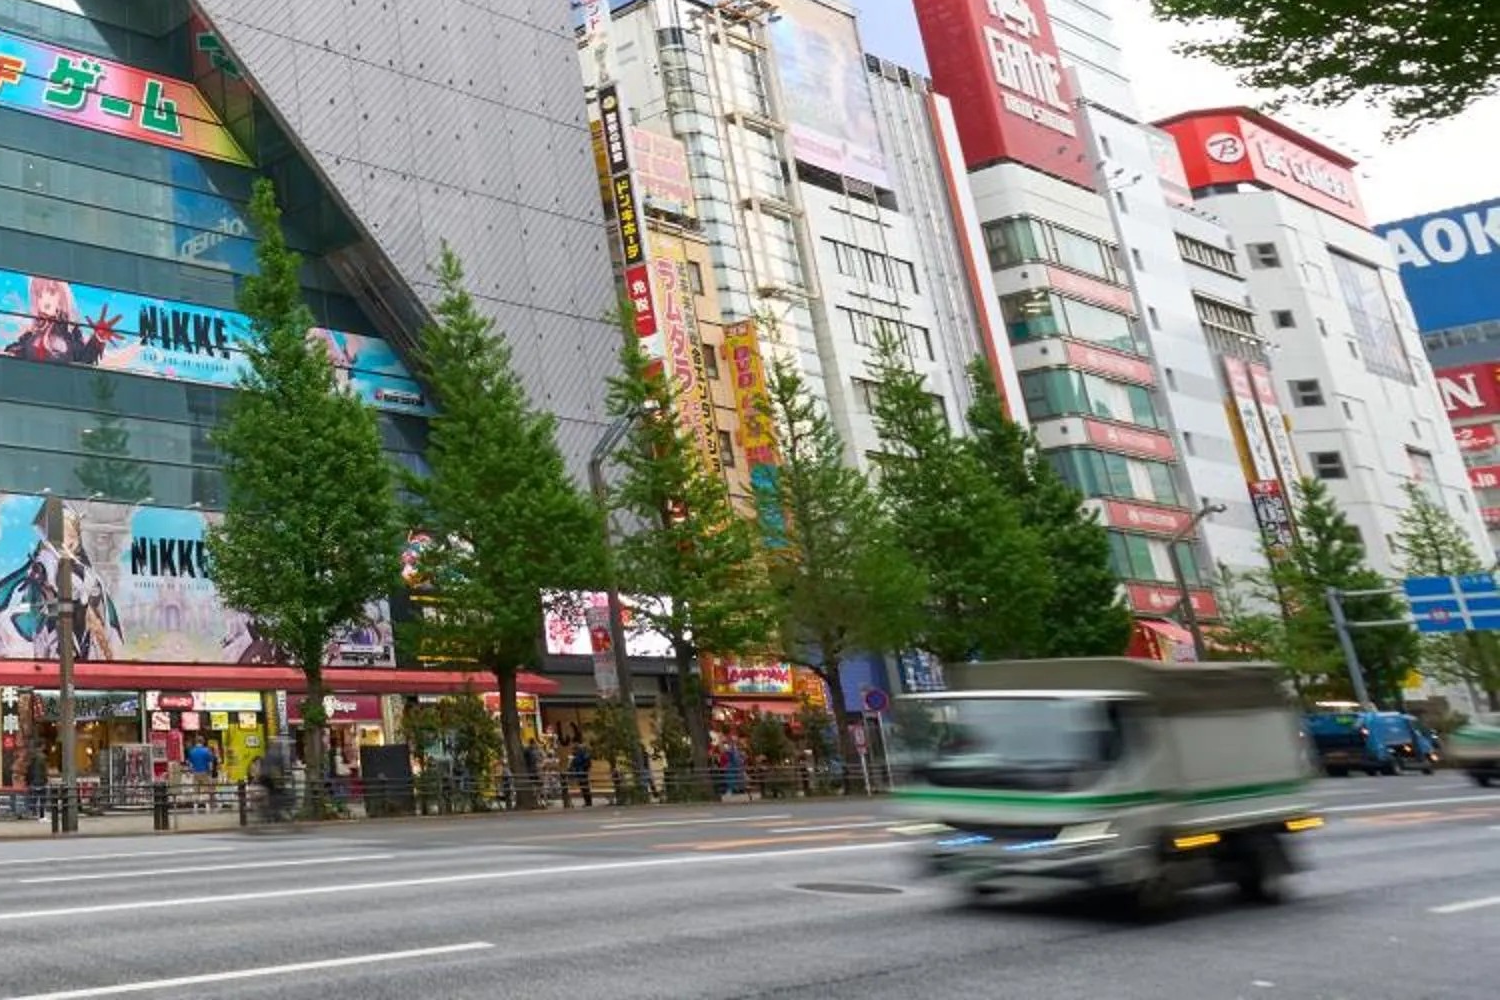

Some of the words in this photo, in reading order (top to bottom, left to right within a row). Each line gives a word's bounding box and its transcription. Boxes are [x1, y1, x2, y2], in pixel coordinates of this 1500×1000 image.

[43, 55, 182, 137] ゲーム
[140, 303, 230, 360] NIKKE
